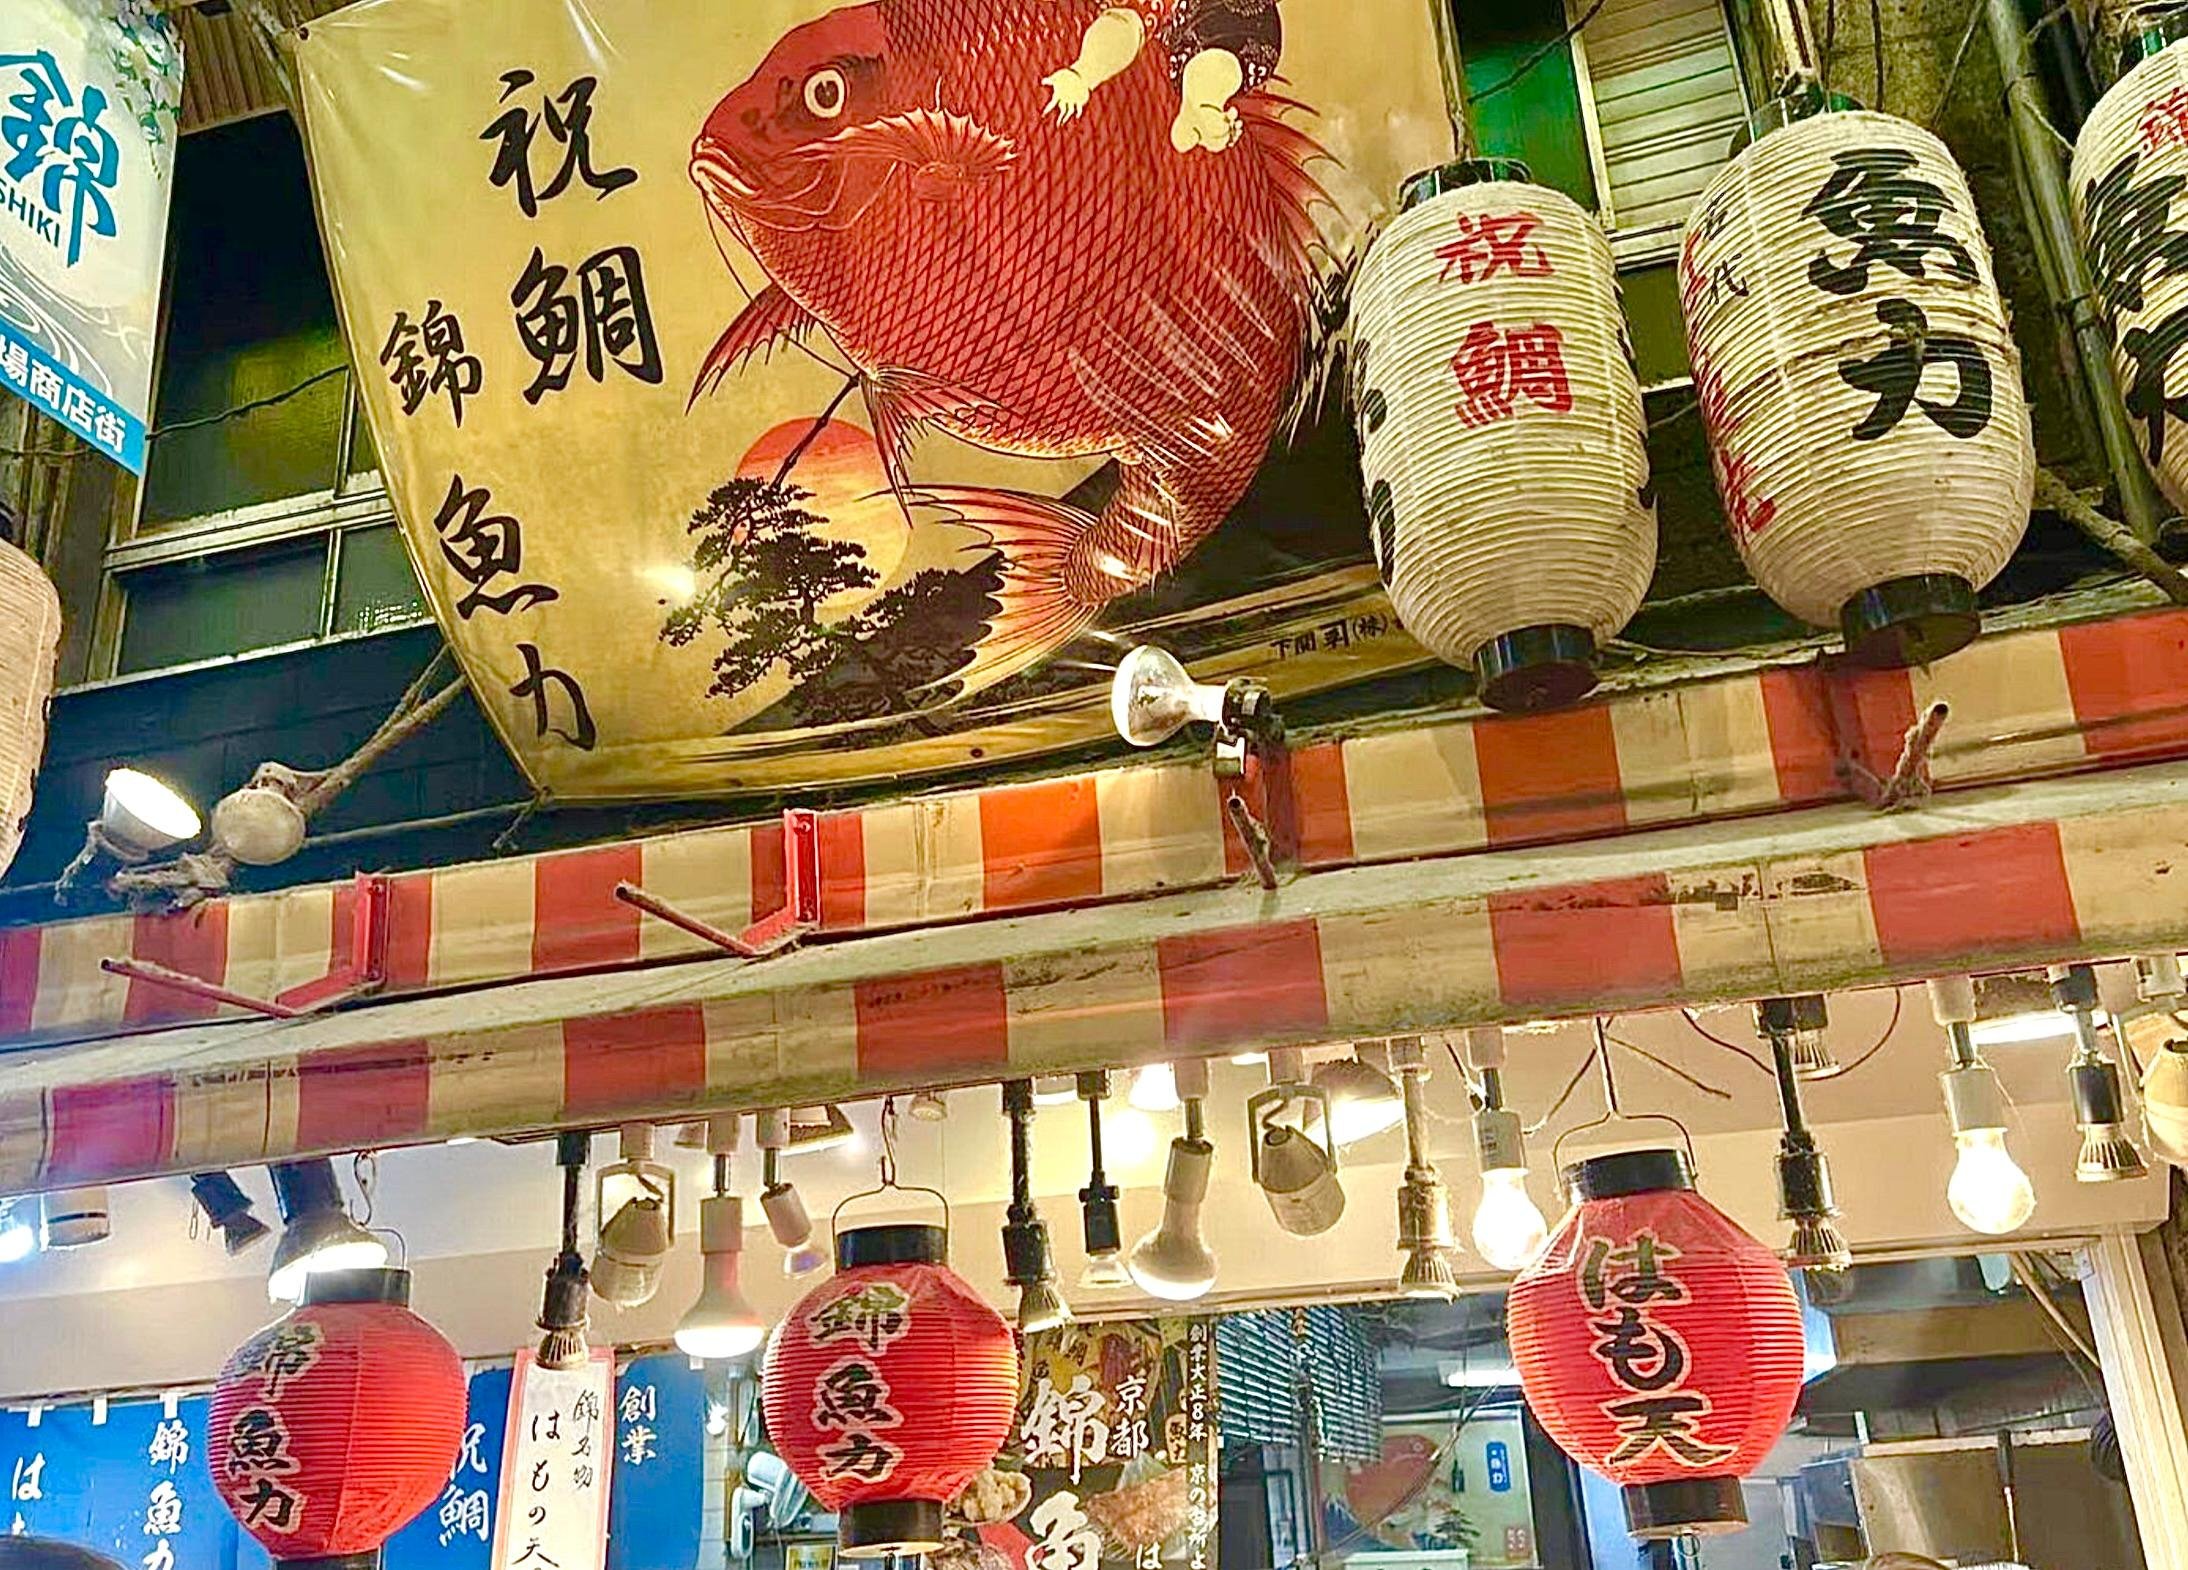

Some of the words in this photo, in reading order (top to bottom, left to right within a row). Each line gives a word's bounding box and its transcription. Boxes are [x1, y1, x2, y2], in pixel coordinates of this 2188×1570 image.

[478, 69, 664, 406] 祝鯛
[1435, 212, 1575, 430] 祝鯛
[1802, 148, 1992, 441] 魚力
[380, 299, 596, 751] 錦魚力
[217, 1322, 318, 1529] 錦魚力
[571, 1389, 600, 1489] 錦名物
[618, 1385, 658, 1466] 創業
[807, 1283, 906, 1480] 錦魚力
[1110, 1375, 1149, 1459] 京都
[1580, 1231, 1736, 1466] はも天
